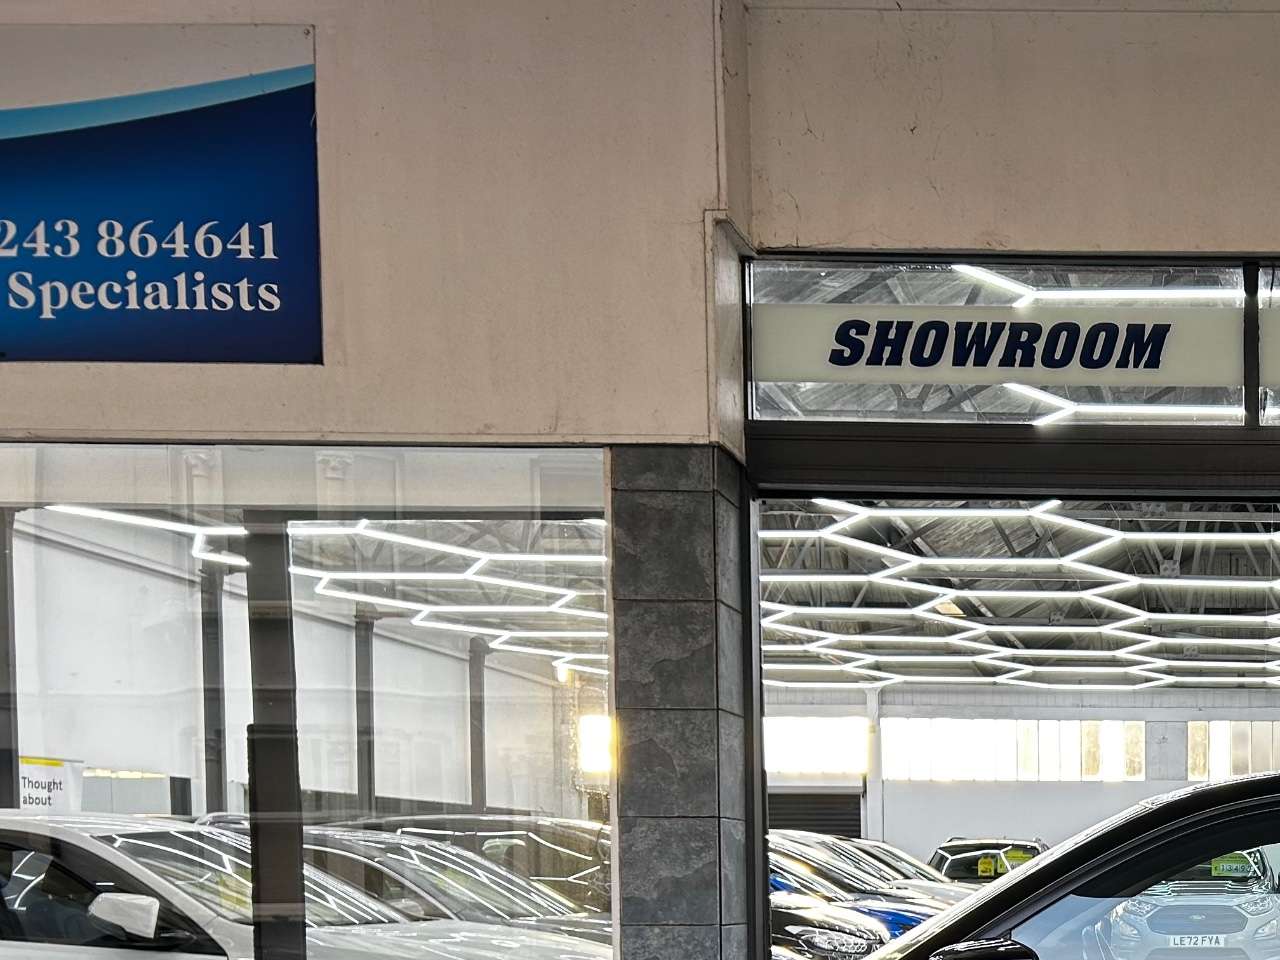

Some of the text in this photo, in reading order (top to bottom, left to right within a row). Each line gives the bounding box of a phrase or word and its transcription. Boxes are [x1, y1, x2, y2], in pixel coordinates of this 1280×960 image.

[97, 220, 279, 259] 864641
[8, 270, 281, 319] Specialists
[828, 319, 1172, 369] SHOWROOM
[21, 776, 63, 793] Thought
[22, 793, 52, 807] about
[1173, 935, 1221, 946] LE72 FYA
